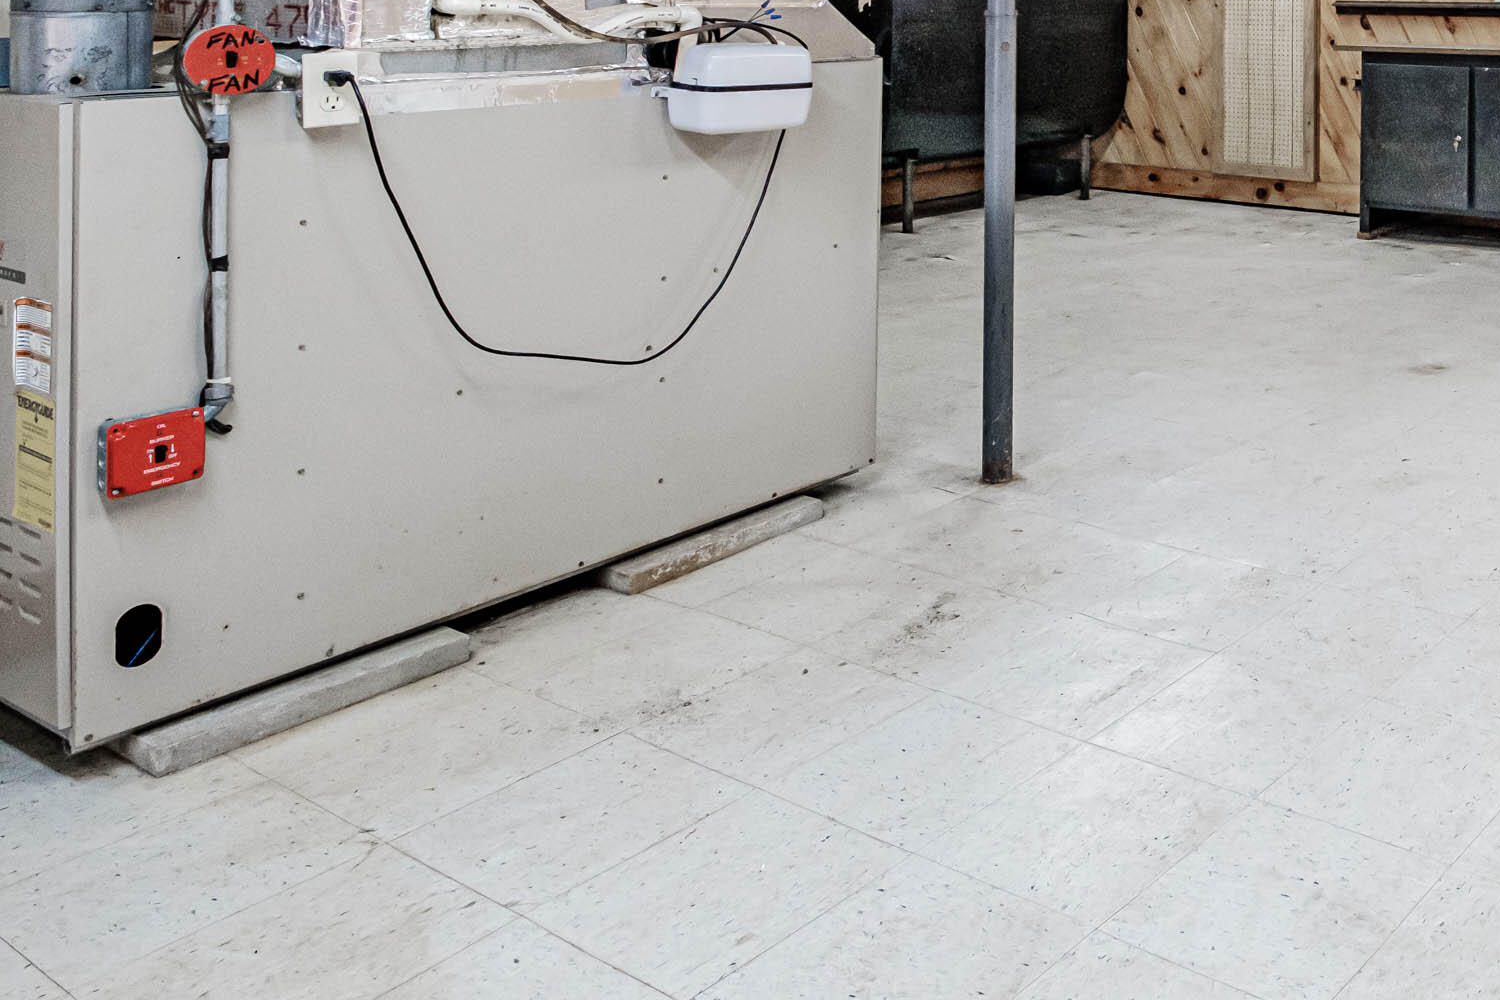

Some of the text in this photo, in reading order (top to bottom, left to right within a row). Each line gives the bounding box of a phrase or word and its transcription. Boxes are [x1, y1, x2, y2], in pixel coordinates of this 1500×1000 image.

[206, 29, 256, 49] FAN
[207, 69, 260, 93] FAN
[143, 460, 181, 475] EMERGENCY
